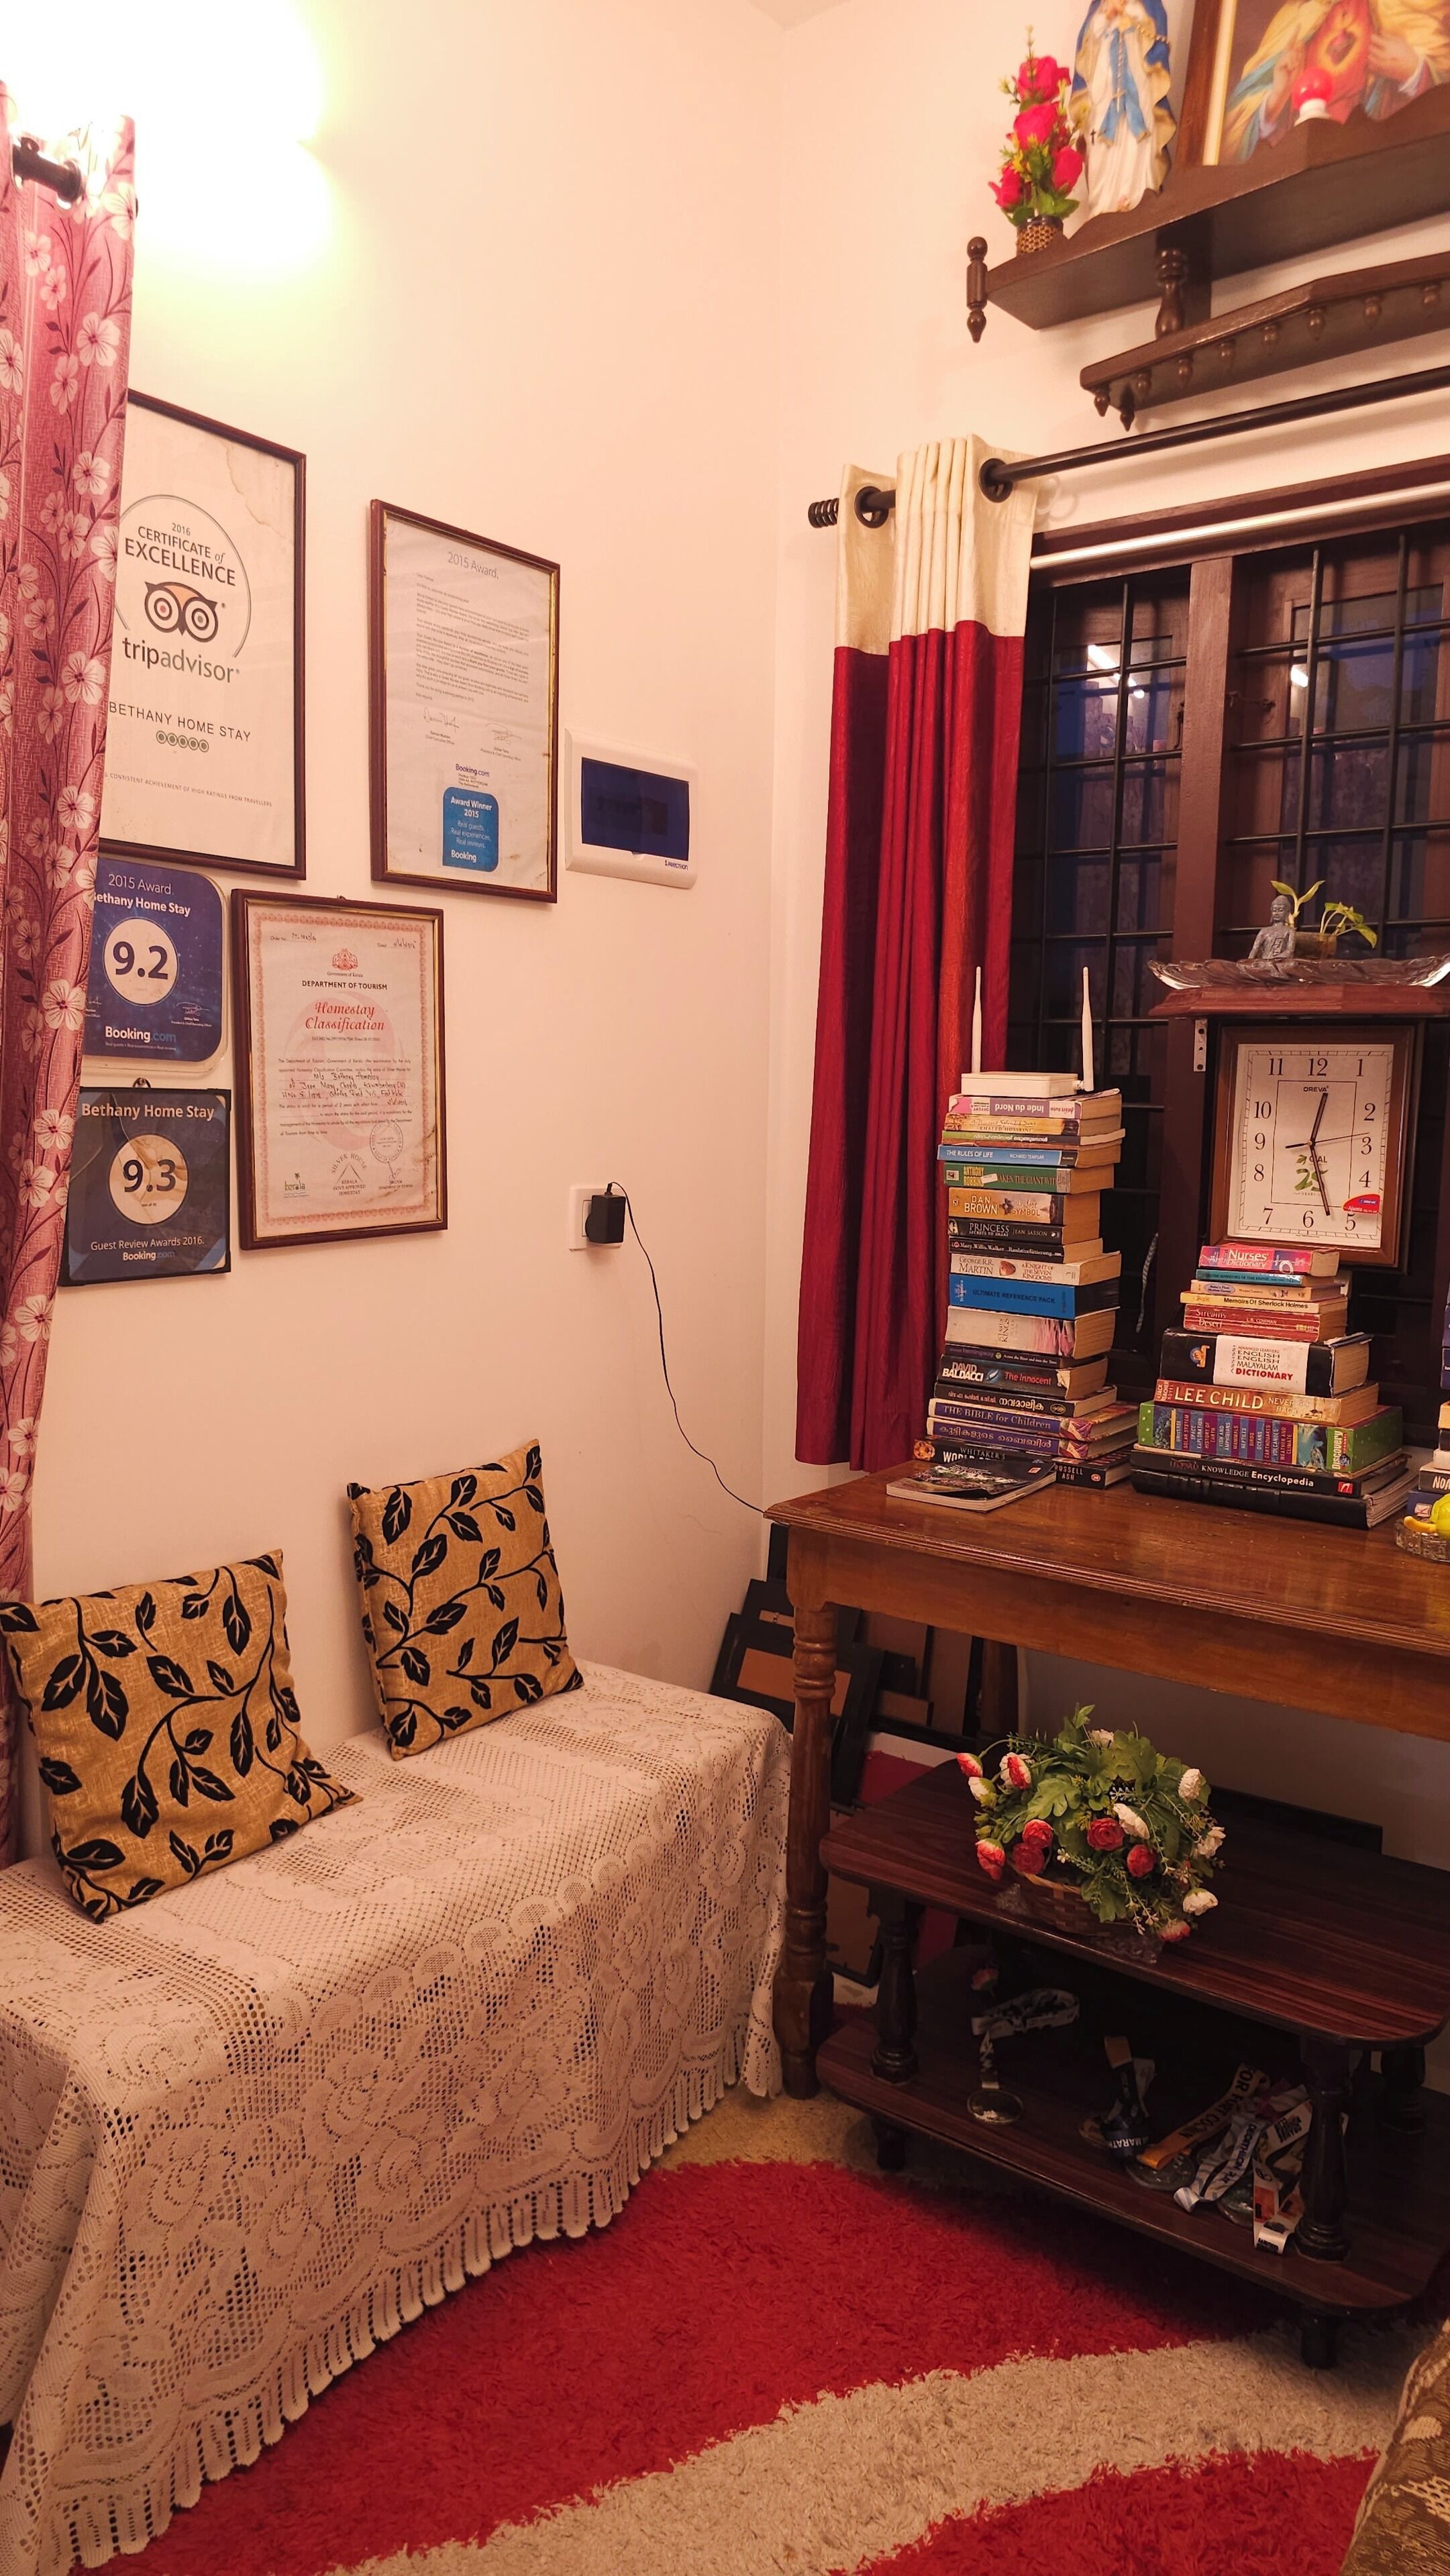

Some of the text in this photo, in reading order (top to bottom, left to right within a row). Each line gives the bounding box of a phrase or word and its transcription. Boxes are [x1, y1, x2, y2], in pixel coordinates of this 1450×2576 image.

[172, 523, 191, 536] 2016
[138, 526, 225, 564] CERTIFICATE of
[125, 537, 236, 586] EXCELLENCE
[448, 551, 469, 569] 2015
[122, 637, 234, 683] tripadvisor
[109, 702, 251, 742] BETHANY HOME STAY
[456, 763, 490, 777] Booking.com
[109, 773, 143, 784] CONSISTENT
[145, 780, 182, 791] ACHIEVEMENT
[207, 790, 227, 799] RATINGS
[451, 796, 493, 811] Award Winner
[464, 809, 479, 818] 2015
[451, 849, 477, 863] Booking
[108, 873, 136, 889] 2015
[136, 898, 167, 912] Home
[168, 903, 191, 917] Stay
[113, 941, 168, 980] 9.2
[302, 980, 346, 989] DEPARTMENT
[315, 1002, 374, 1018] Homestay
[305, 1016, 384, 1033] Classification
[1268, 1058, 1363, 1077] 11 12 1
[81, 1103, 215, 1121] Bethany Home Stay
[995, 1103, 1044, 1113] Inde du Nord
[1254, 1101, 1376, 1121] 10 2
[1255, 1132, 1372, 1155] 9 3
[331, 1153, 367, 1175] SILVER HOUSE
[964, 1166, 984, 1176] ANTHONY
[123, 1159, 176, 1193] 9.3
[1026, 1176, 1043, 1184] GIANT
[1253, 1164, 1371, 1187] 8 4
[1294, 1169, 1329, 1191] 25
[972, 1195, 990, 1203] DAN
[964, 1203, 998, 1214] BROWN
[1263, 1208, 1356, 1231] 7 6 5
[969, 1223, 1010, 1233] PRINCESS
[91, 1242, 116, 1250] Guest
[119, 1239, 148, 1249] Review
[150, 1238, 180, 1247] Awards
[959, 1256, 982, 1265] GEORGE
[1229, 1250, 1269, 1261] Nurses'
[959, 1263, 993, 1275] MARTIN
[1227, 1259, 1266, 1268] Dictionary
[973, 1289, 1000, 1298] ULTIMATE
[1002, 1293, 1037, 1301] REFERENCE
[1196, 1309, 1227, 1319] Streams
[1199, 1318, 1223, 1328] Desert
[1237, 1350, 1280, 1358] ENGLISH
[1237, 1356, 1280, 1364] ENGLISH
[952, 1362, 977, 1372] DAVID
[1237, 1361, 1278, 1371] MALAYALAM
[942, 1368, 984, 1382] BALDACCI
[1004, 1371, 1051, 1385] The Innocent
[1235, 1368, 1294, 1381] DICTIONARY
[1161, 1381, 1169, 1401] REACHER
[1174, 1386, 1263, 1409] LEE CHILD
[999, 1397, 1044, 1411] നവമാലിക
[1267, 1397, 1294, 1407] NEVER
[943, 1405, 1051, 1430] THE BIBLE for Children
[939, 1426, 1051, 1448] കുട്ടികളുടെ ബൈബിൾ
[960, 1447, 1005, 1460] WHITAKER'S
[1054, 1464, 1083, 1475] RUSSELL
[1061, 1472, 1074, 1481] ASH
[1202, 1465, 1314, 1487] KNOWLEDGE Encyclopedia
[1233, 2124, 1257, 2169] DECATHLON
